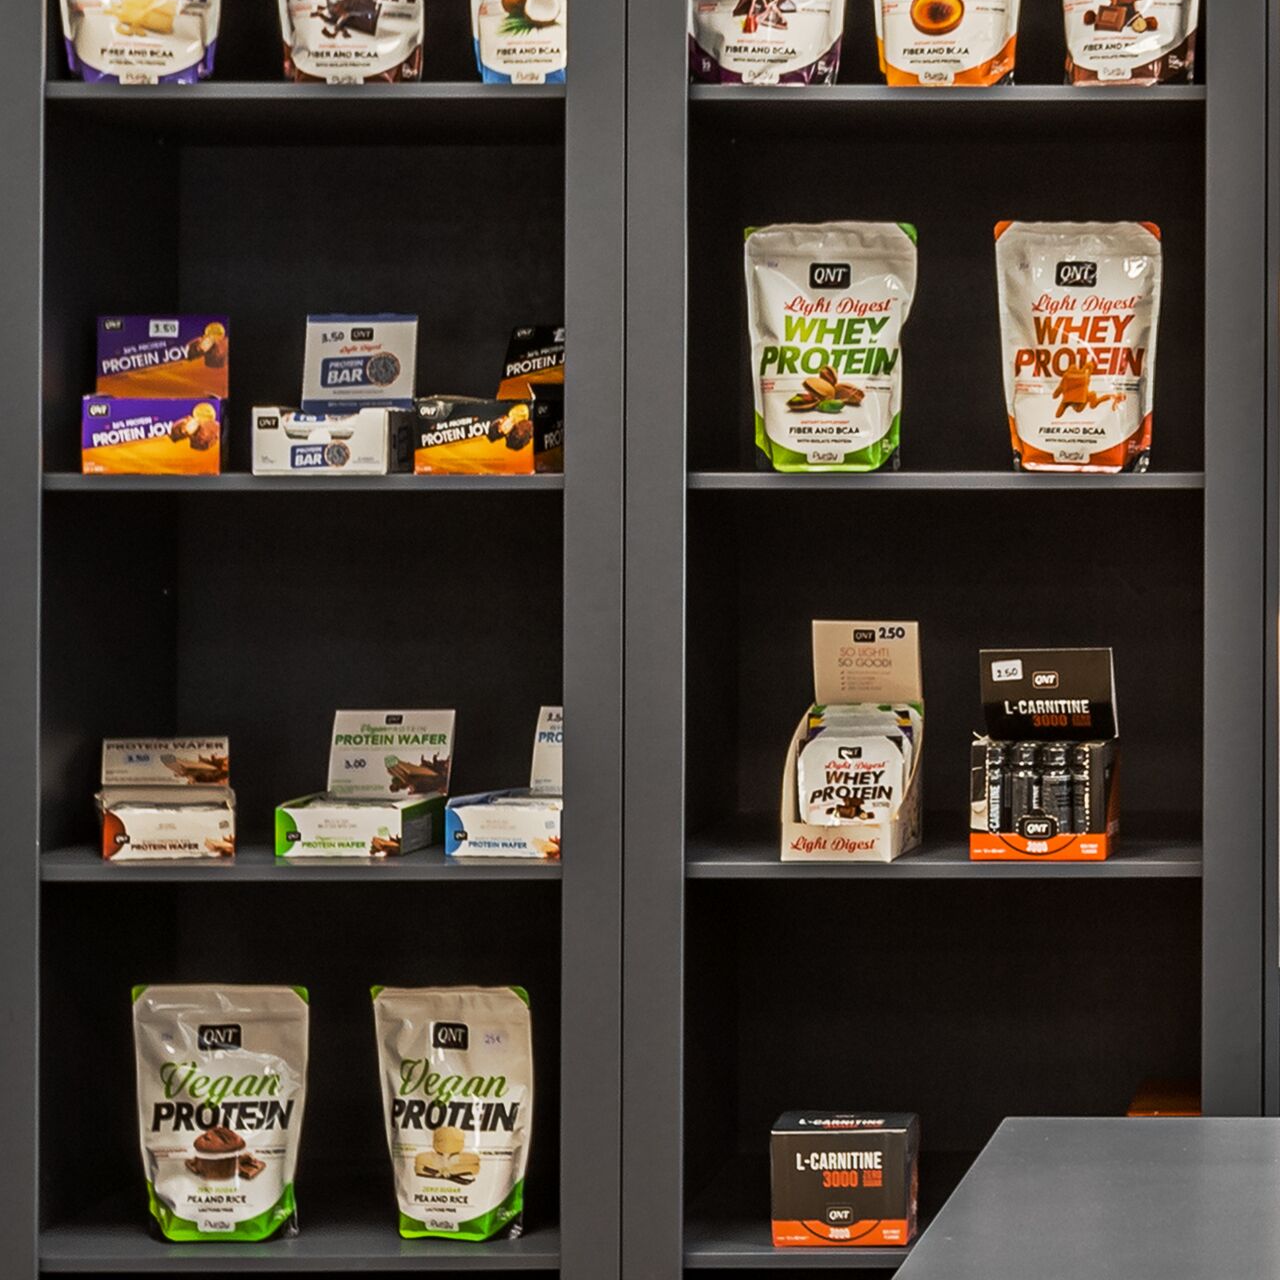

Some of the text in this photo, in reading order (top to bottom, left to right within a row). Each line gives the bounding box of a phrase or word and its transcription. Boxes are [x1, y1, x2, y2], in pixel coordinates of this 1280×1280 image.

[128, 49, 174, 57] AND BCAA
[307, 50, 331, 58] FIBER
[496, 48, 517, 56] FIBER
[725, 46, 748, 54] FIBER
[902, 47, 925, 55] FIBER
[927, 47, 944, 55] AND
[814, 268, 844, 284] QNT
[1060, 265, 1093, 283] QNT
[784, 296, 891, 316] Light Digest
[1032, 294, 1136, 314] Light Digest
[784, 315, 890, 345] WHEY
[1033, 315, 1136, 345] WHEY
[102, 345, 190, 374] PROTEIN JOY
[329, 359, 363, 369] PROTEIN
[506, 355, 557, 376] PROTEIN
[760, 346, 899, 377] PROTEIN
[1015, 348, 1145, 378] PROTEIN
[327, 369, 363, 384] BAR
[259, 419, 276, 427] QNT
[789, 426, 860, 435] FIBER AND BCAA
[92, 421, 173, 447] PROTEIN JOY
[421, 421, 491, 447] PROTEIN JOY
[1038, 427, 1061, 435] FIBER
[1082, 427, 1106, 435] BCAA
[295, 453, 322, 466] BAR
[855, 631, 874, 641] QNT
[840, 648, 855, 657] SO
[838, 658, 853, 668] SO
[1034, 675, 1056, 685] QNT
[1004, 700, 1089, 715] L-CARNITINE
[1032, 715, 1068, 727] 3000
[174, 742, 224, 750] WAFER
[335, 734, 447, 745] PROTEIN WAFER
[855, 761, 886, 770] Digest
[826, 770, 885, 786] WHEY
[810, 786, 893, 804] PROTEIN
[1027, 822, 1048, 835] QNT
[790, 836, 876, 852] Light Digest
[203, 1029, 235, 1044] QNT
[437, 1027, 466, 1043] QNT
[160, 1061, 280, 1108] Vegan
[400, 1057, 507, 1104] Vegan
[152, 1100, 294, 1132] PROTEIN
[391, 1098, 520, 1132] PROTEIN
[796, 1152, 882, 1170] L-CARNITINE
[822, 1171, 858, 1188] 3000
[187, 1194, 246, 1204] PEA AND RICE
[414, 1194, 468, 1204] PEA AND RICE
[829, 1211, 850, 1220] QNT
